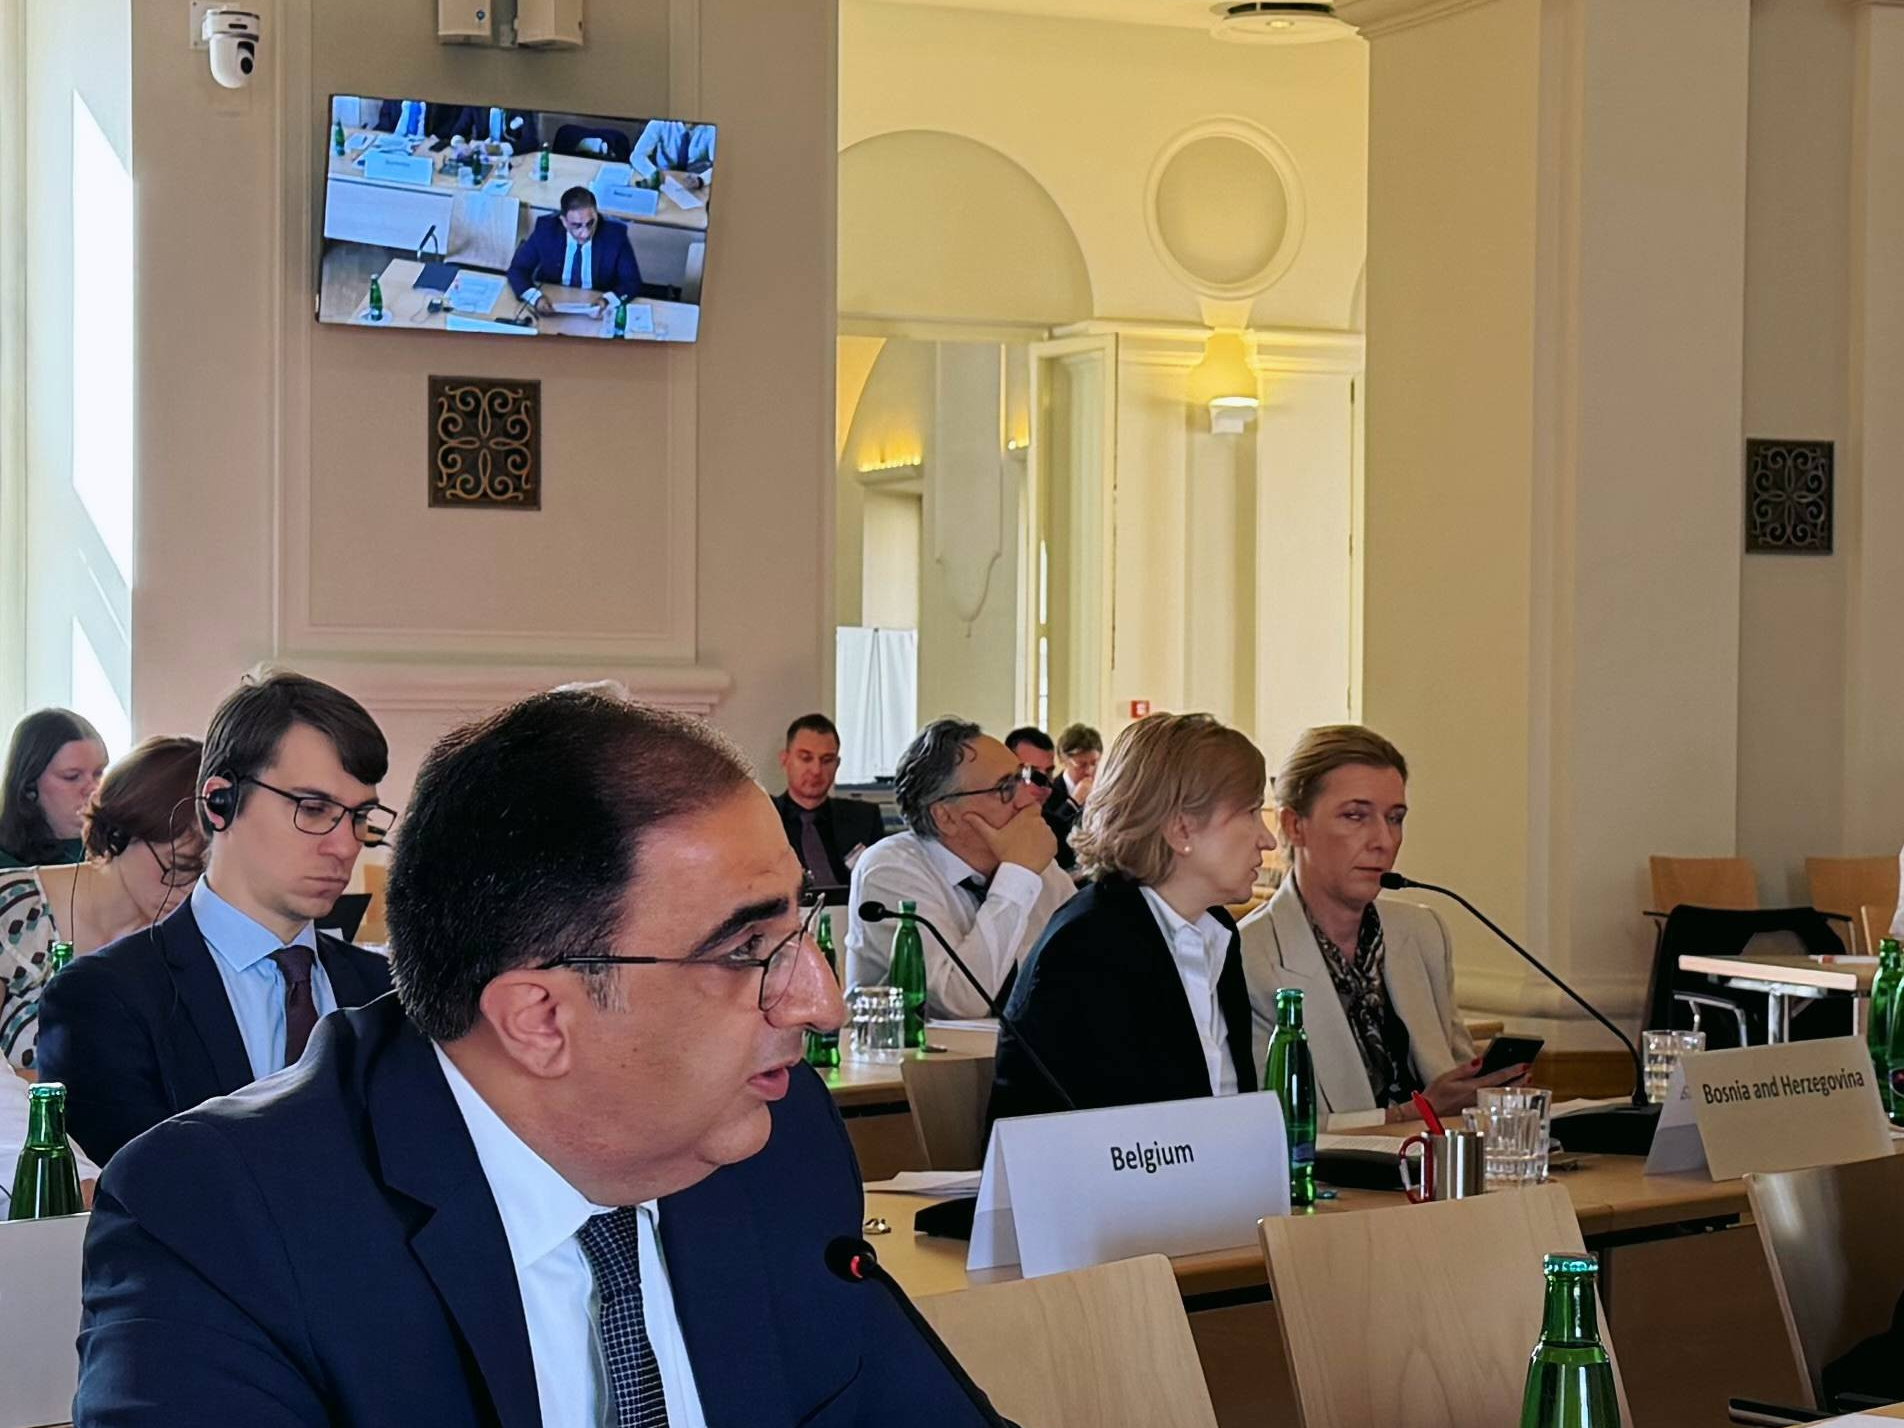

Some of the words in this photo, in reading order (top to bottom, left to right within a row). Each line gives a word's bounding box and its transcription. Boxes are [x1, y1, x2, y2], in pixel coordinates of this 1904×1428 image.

[1702, 1079, 1751, 1105] Bosnia
[1752, 1075, 1780, 1100] and
[1780, 1067, 1866, 1097] Herzegovina
[1110, 1140, 1195, 1174] Belgium
